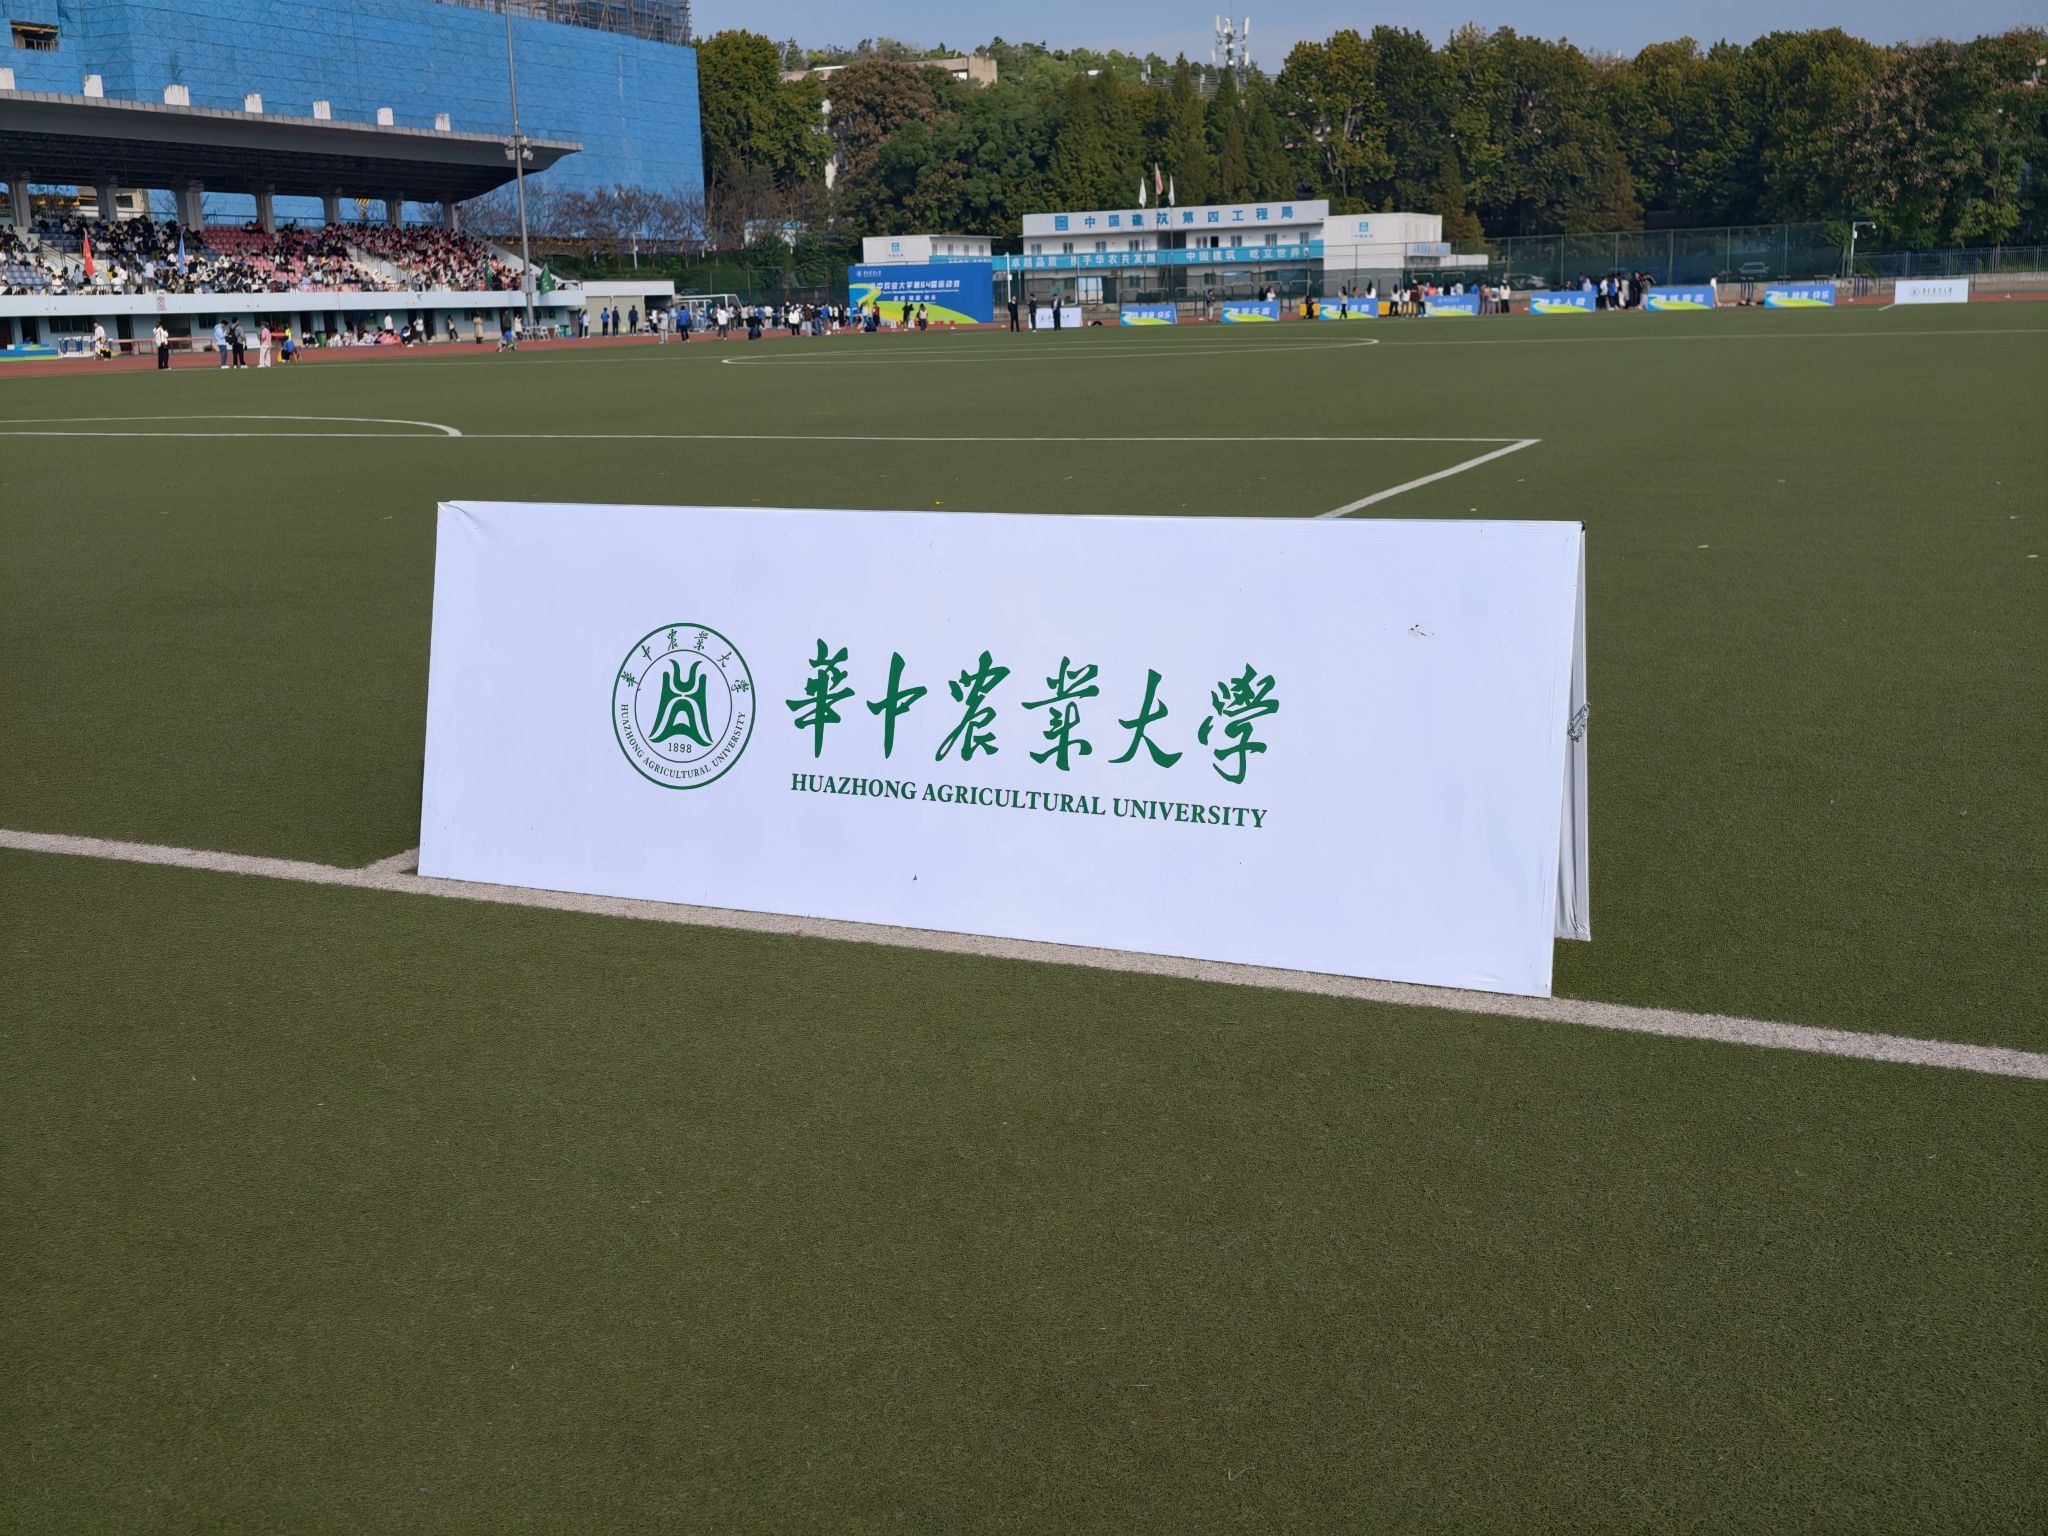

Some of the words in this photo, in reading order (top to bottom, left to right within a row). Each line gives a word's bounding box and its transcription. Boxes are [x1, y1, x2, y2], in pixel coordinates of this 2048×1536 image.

[1085, 206, 1294, 229] 中国建筑第四工程局
[621, 704, 645, 758] HUAZHONG
[642, 755, 712, 779] AGRICULTURAL
[711, 712, 746, 768] UNIVERSITY
[668, 742, 693, 754] 1898
[791, 773, 917, 799] HUAZHONG
[922, 784, 1106, 816] AGRICULTURAL
[1113, 798, 1268, 829] UNIVERSITY
